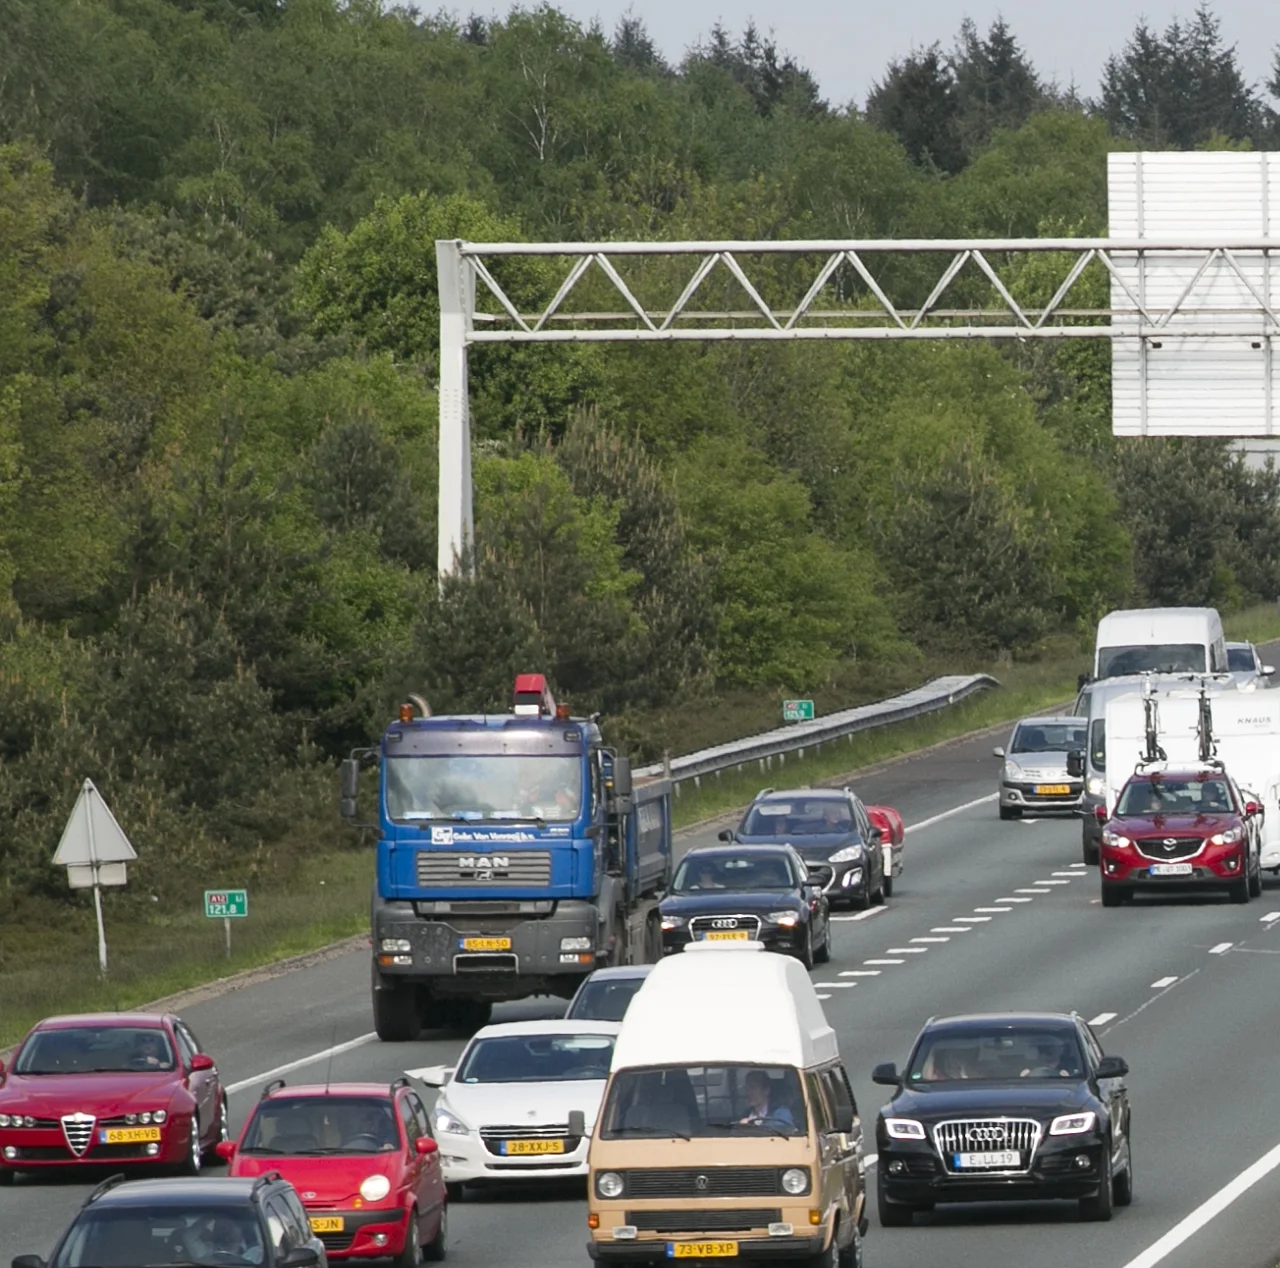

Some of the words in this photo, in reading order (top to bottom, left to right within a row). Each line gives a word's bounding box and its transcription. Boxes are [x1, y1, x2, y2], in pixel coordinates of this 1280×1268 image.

[1236, 717, 1272, 725] KNAUS
[459, 857, 509, 868] MAN
[109, 1130, 158, 1141] 68-XH-VB
[511, 1142, 559, 1153] 28-XXJ-5
[679, 1244, 734, 1256] 73-VB-XP
